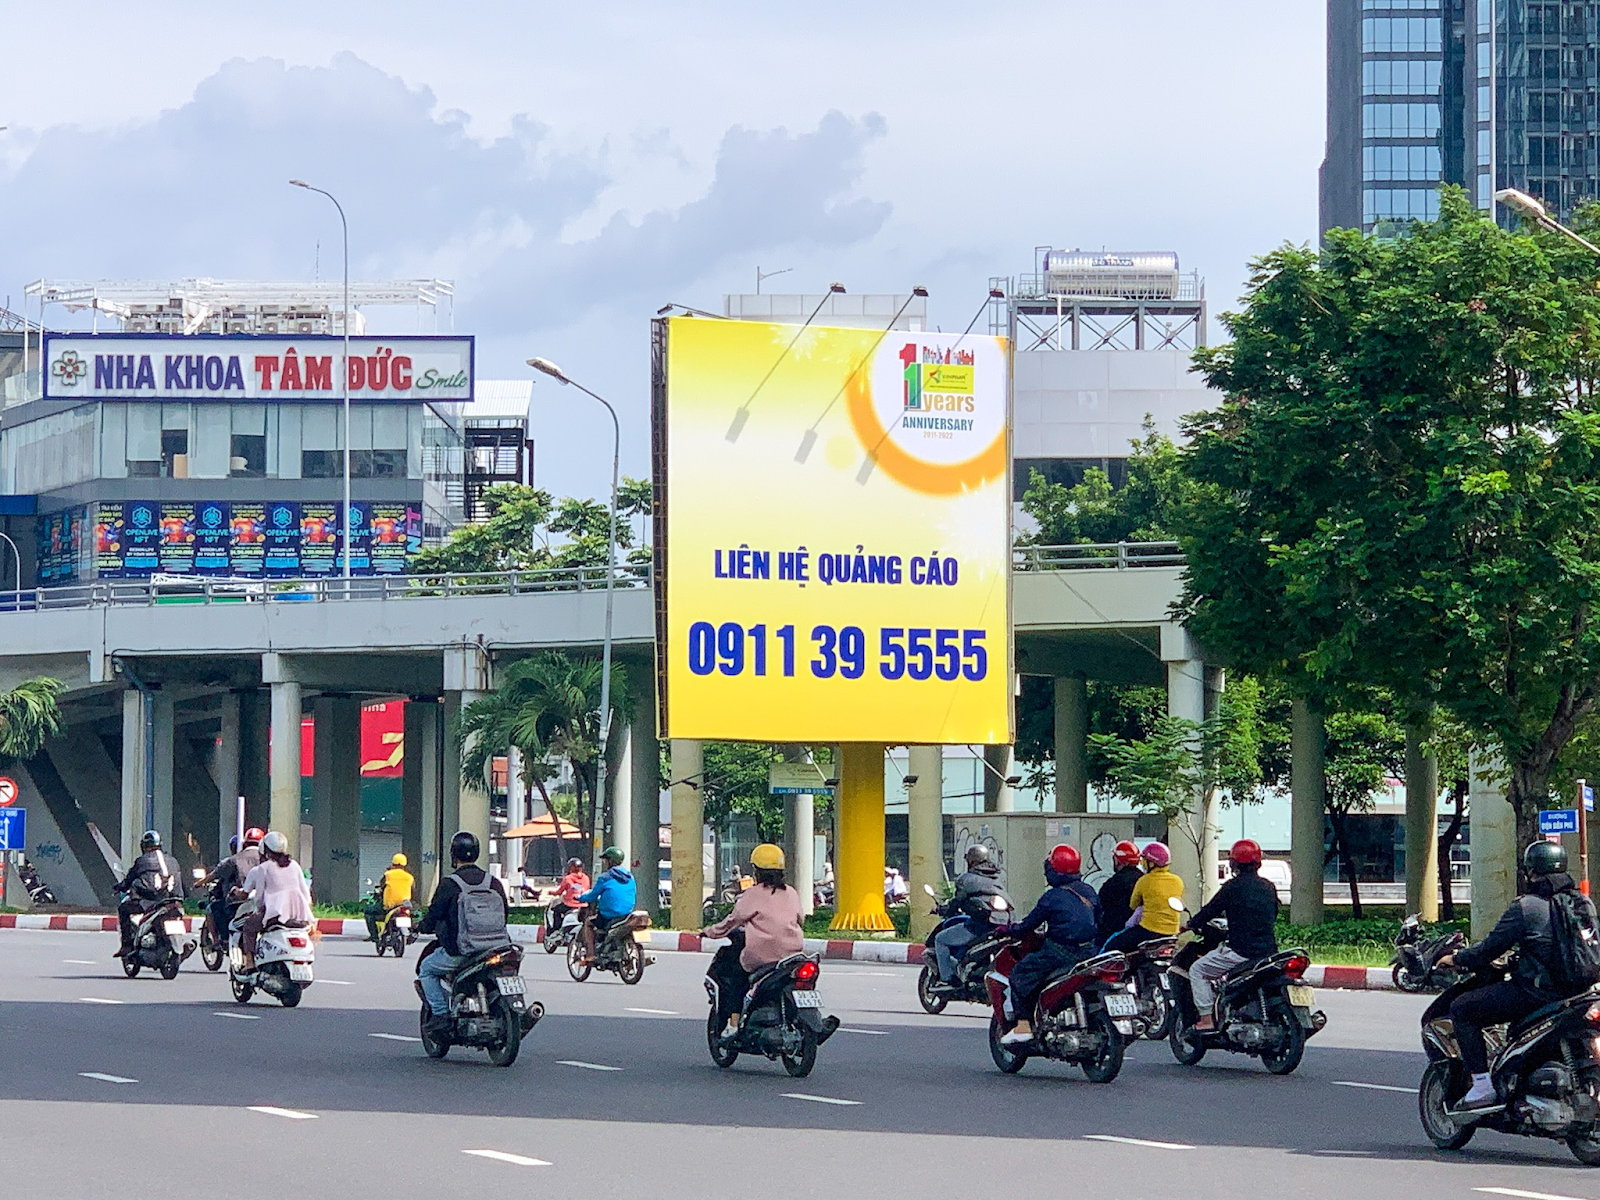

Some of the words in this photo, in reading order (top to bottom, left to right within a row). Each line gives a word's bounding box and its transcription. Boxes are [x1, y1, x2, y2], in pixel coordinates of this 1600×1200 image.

[94, 354, 156, 390] NHA
[164, 354, 245, 390] KHOA
[255, 347, 333, 390] TÂM
[345, 346, 412, 390] ĐỨC
[415, 369, 468, 389] Smile
[902, 416, 974, 432] ANNIVERSARY
[923, 394, 975, 413] years
[407, 507, 421, 554] NFT
[714, 544, 770, 580] LIÊN
[779, 546, 809, 588] HỆ
[818, 545, 901, 586] QUẢNG
[910, 551, 958, 586] CÁO
[688, 621, 795, 678] 0911
[811, 625, 865, 680] 39
[880, 627, 987, 681] 5555
